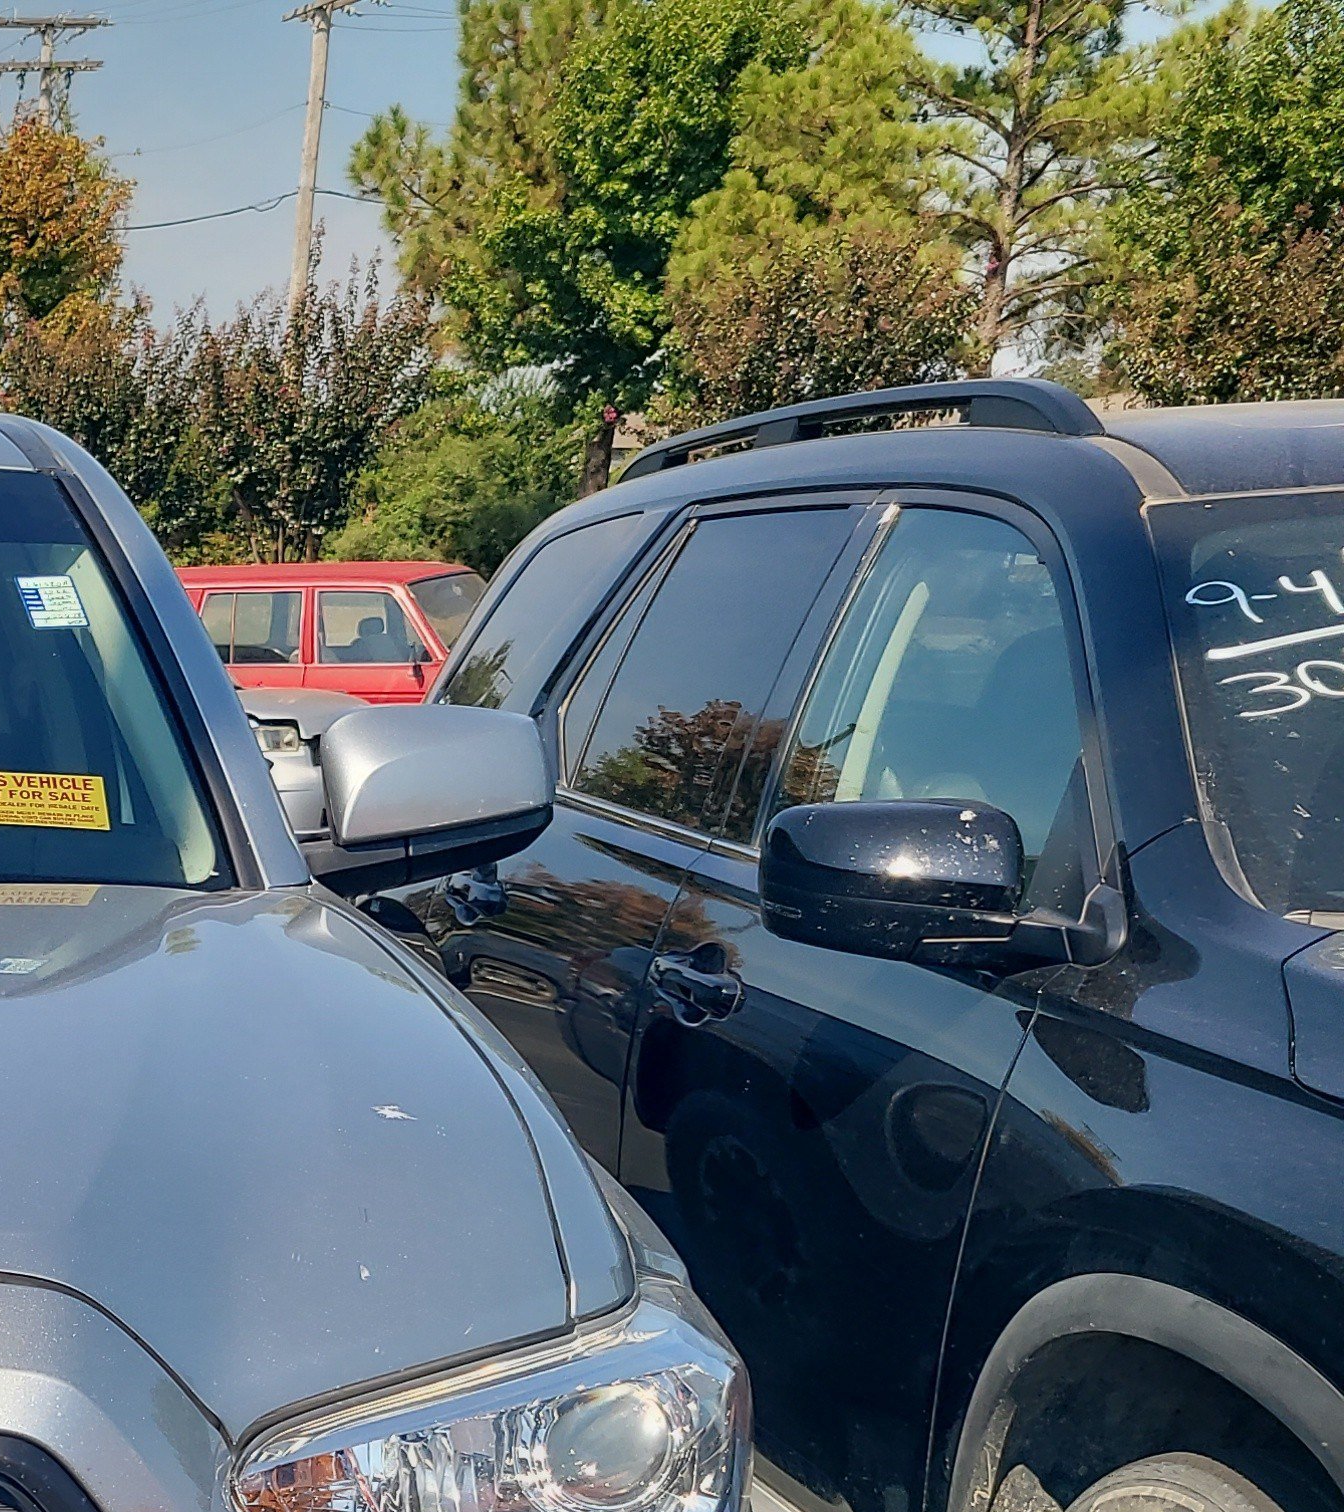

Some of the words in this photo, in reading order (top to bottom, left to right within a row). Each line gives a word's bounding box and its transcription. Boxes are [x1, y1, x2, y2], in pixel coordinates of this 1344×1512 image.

[12, 775, 95, 791] VEHICLE
[8, 789, 43, 800] FOR
[49, 791, 92, 803] SALE
